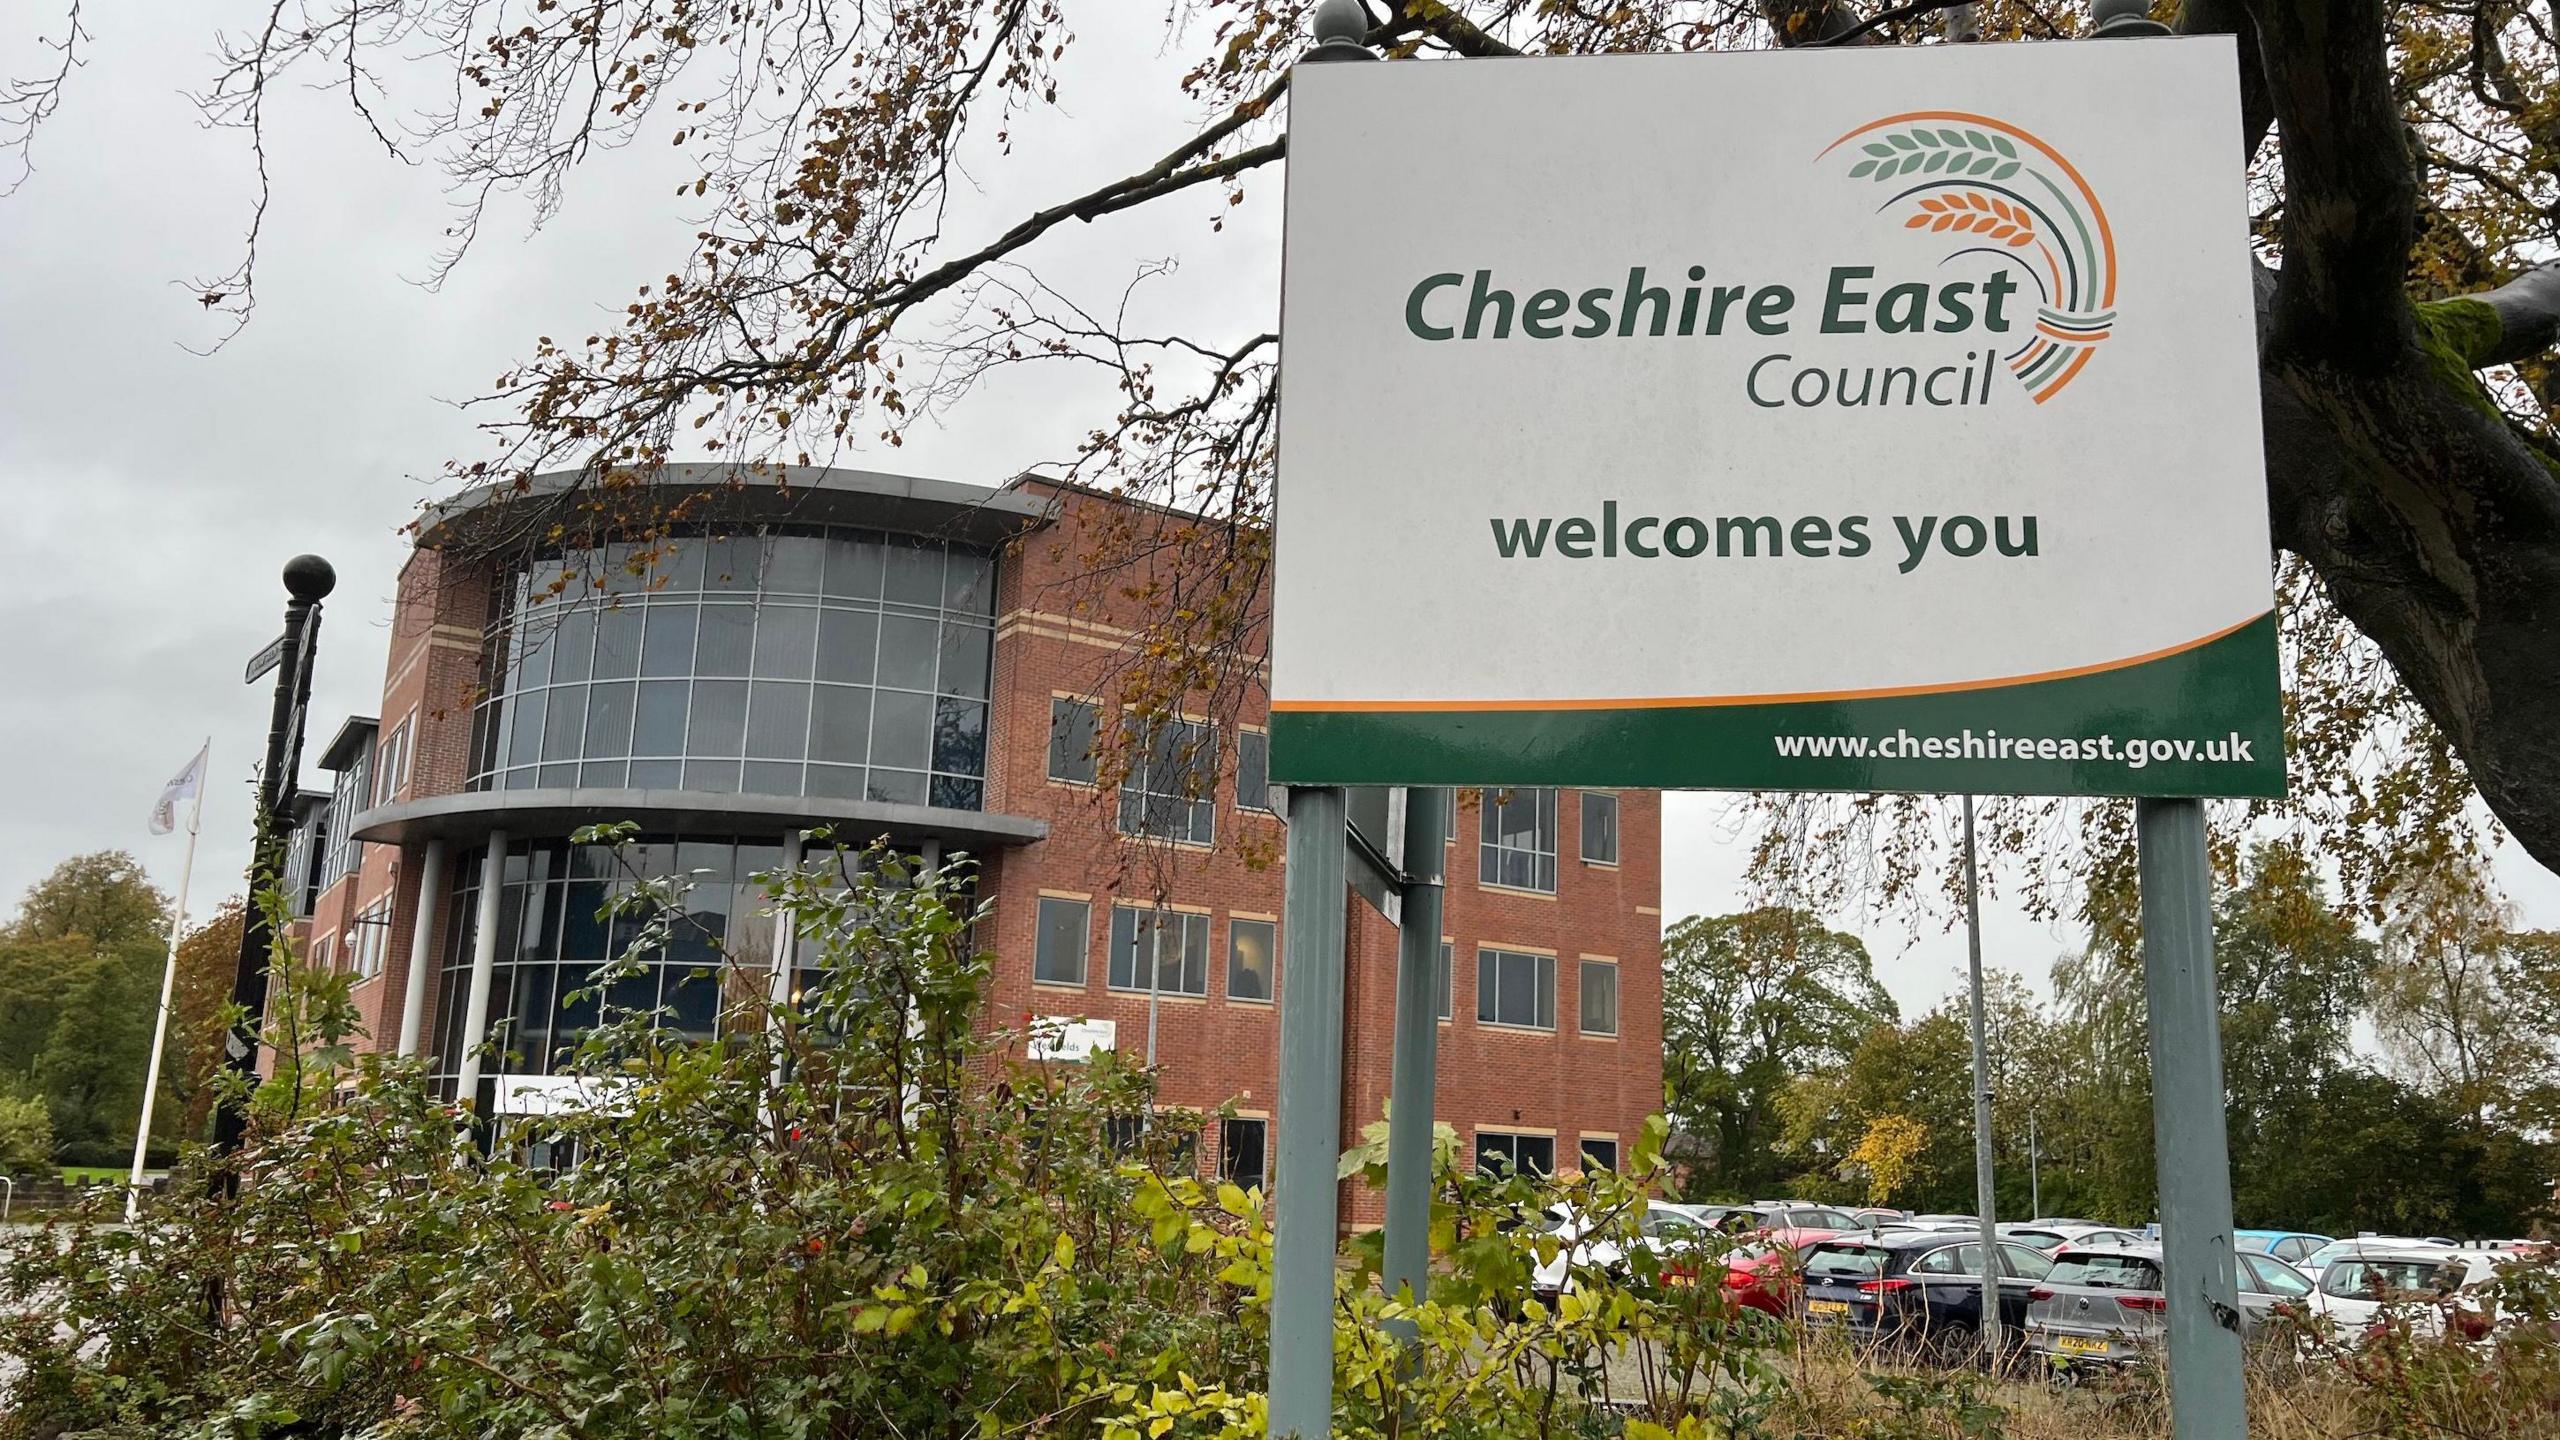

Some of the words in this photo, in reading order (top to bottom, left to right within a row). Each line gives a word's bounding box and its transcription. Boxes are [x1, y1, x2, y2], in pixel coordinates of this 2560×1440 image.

[1406, 266, 1796, 341] Cheshire
[1819, 265, 2018, 335] East
[1746, 349, 1996, 408] Council
[1489, 500, 1872, 559] welcomes
[1892, 515, 2039, 576] you
[1774, 729, 2254, 769] www.cheshireeast.gov.uk
